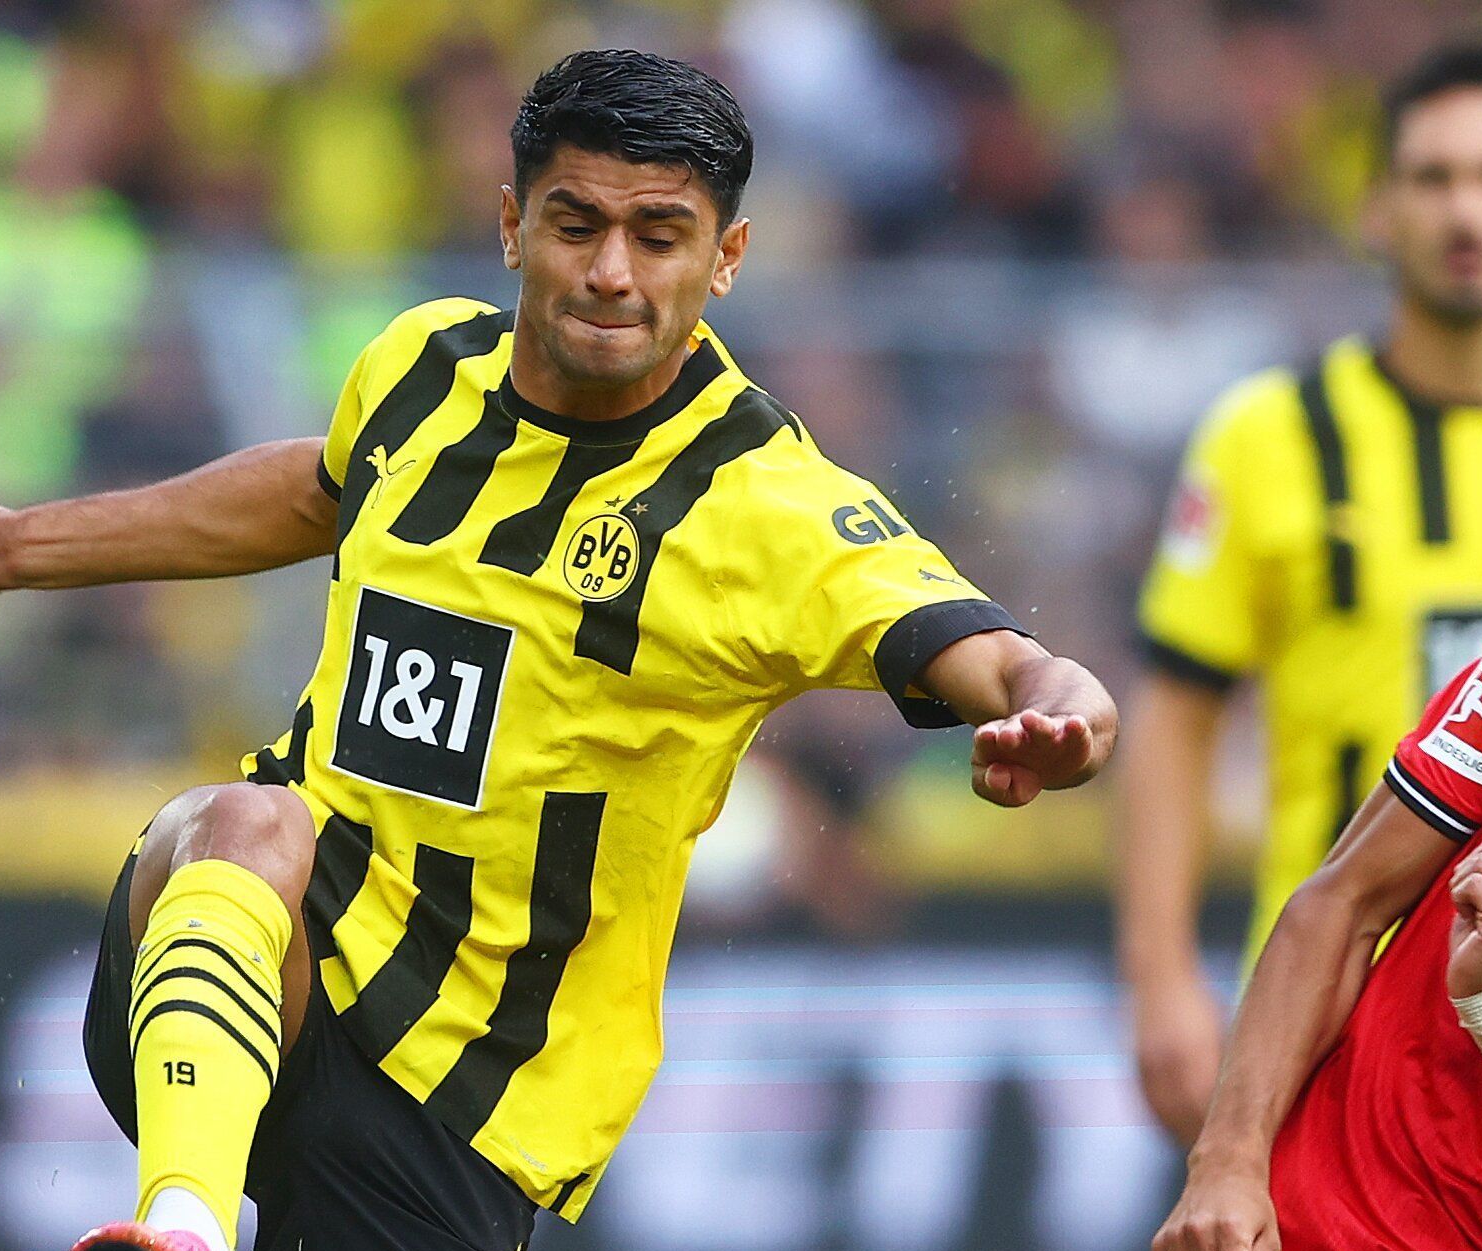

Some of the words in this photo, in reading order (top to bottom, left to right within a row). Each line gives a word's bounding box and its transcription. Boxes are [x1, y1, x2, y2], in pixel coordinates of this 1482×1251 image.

[571, 521, 632, 580] BVB
[580, 572, 605, 592] 09
[357, 633, 484, 753] 1&1
[163, 1061, 196, 1087] 19
